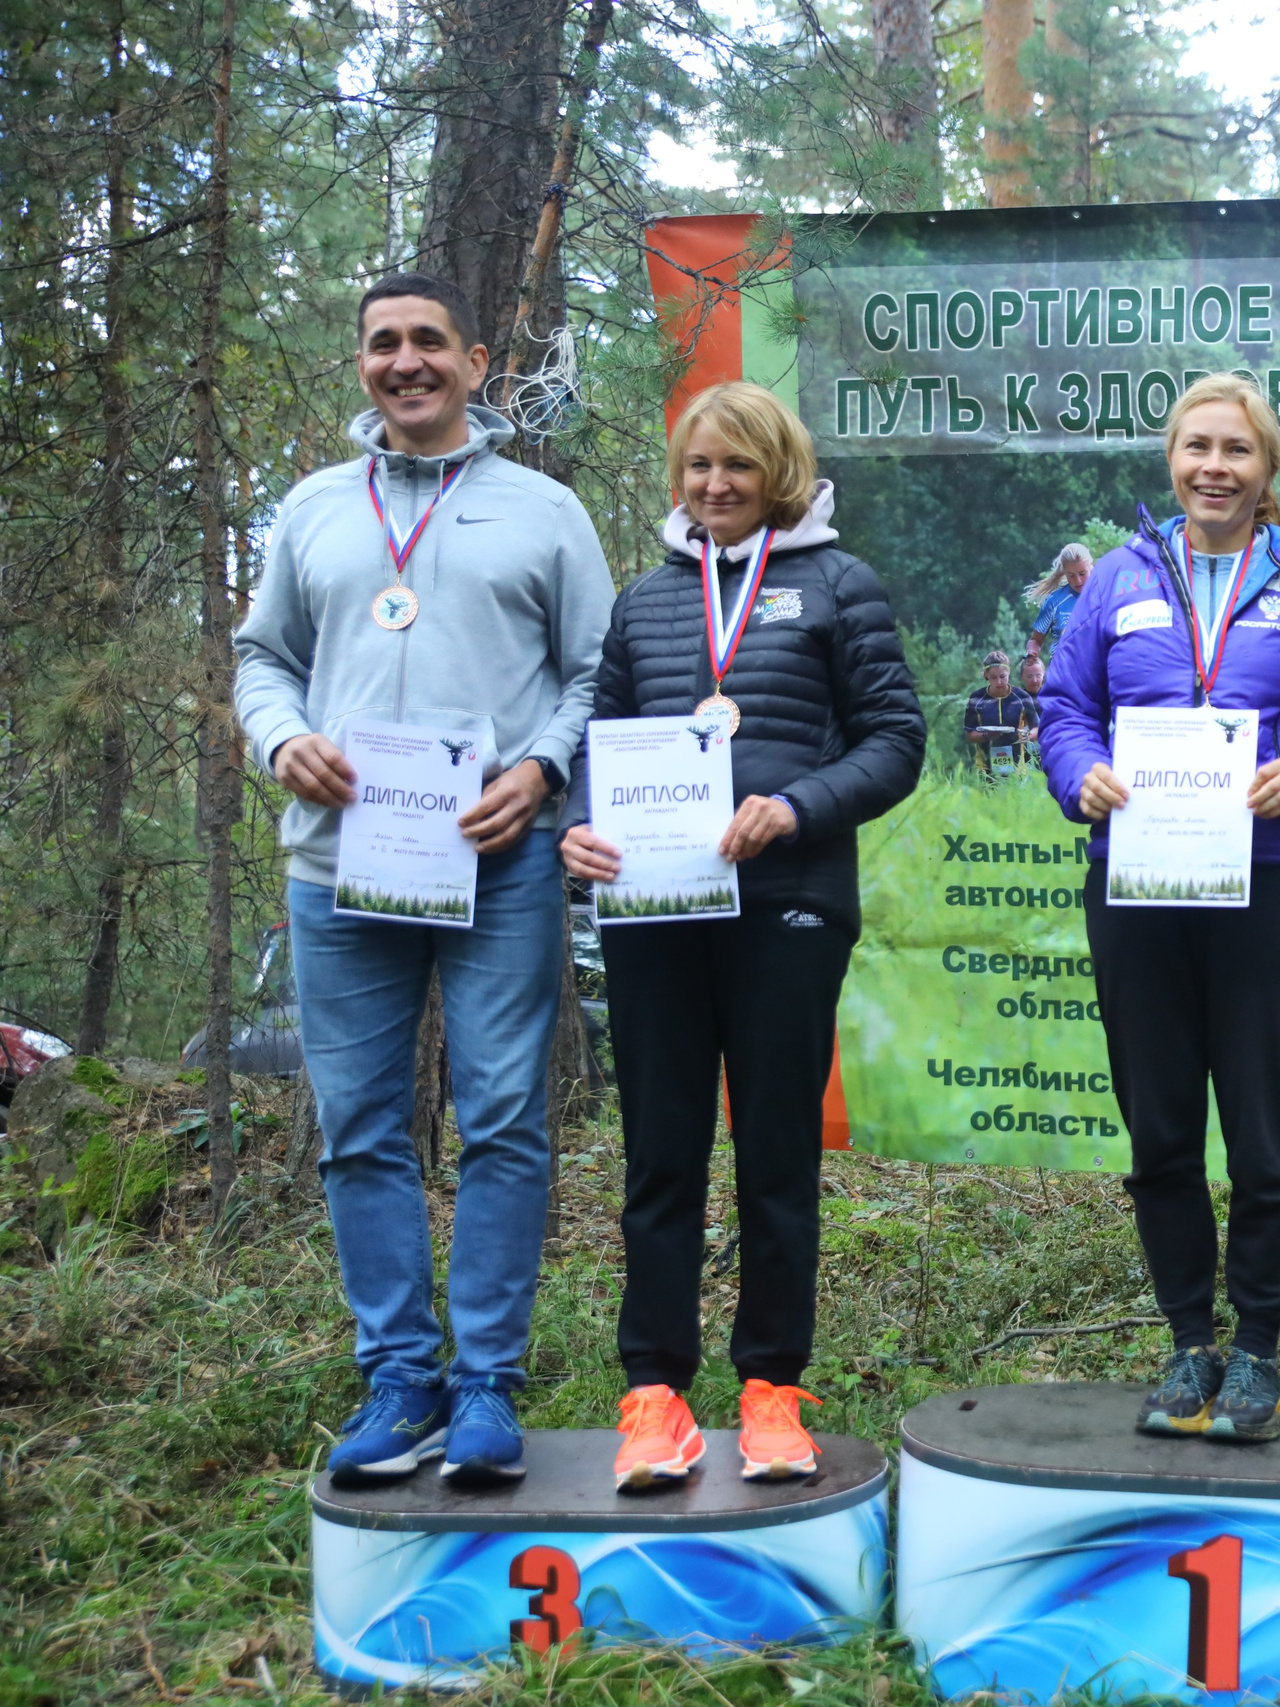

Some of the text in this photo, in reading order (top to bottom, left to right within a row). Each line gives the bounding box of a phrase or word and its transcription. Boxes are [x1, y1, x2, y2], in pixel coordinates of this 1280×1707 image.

[863, 284, 1274, 352] СПОРТИВНОЕ
[835, 376, 984, 437] ПУТЬ
[1005, 373, 1041, 433] К
[611, 783, 711, 806] ДИПЛОМ
[1132, 770, 1231, 788] ДИПЛОМ
[363, 785, 458, 812] ДИПЛОМ
[945, 885, 1084, 909] автоно
[942, 945, 1096, 982] Свердло
[996, 991, 1102, 1022] облас
[927, 1058, 1118, 1093] Челябинс
[969, 1104, 1120, 1137] область
[509, 1545, 582, 1662] 3
[1168, 1533, 1243, 1692] 1
